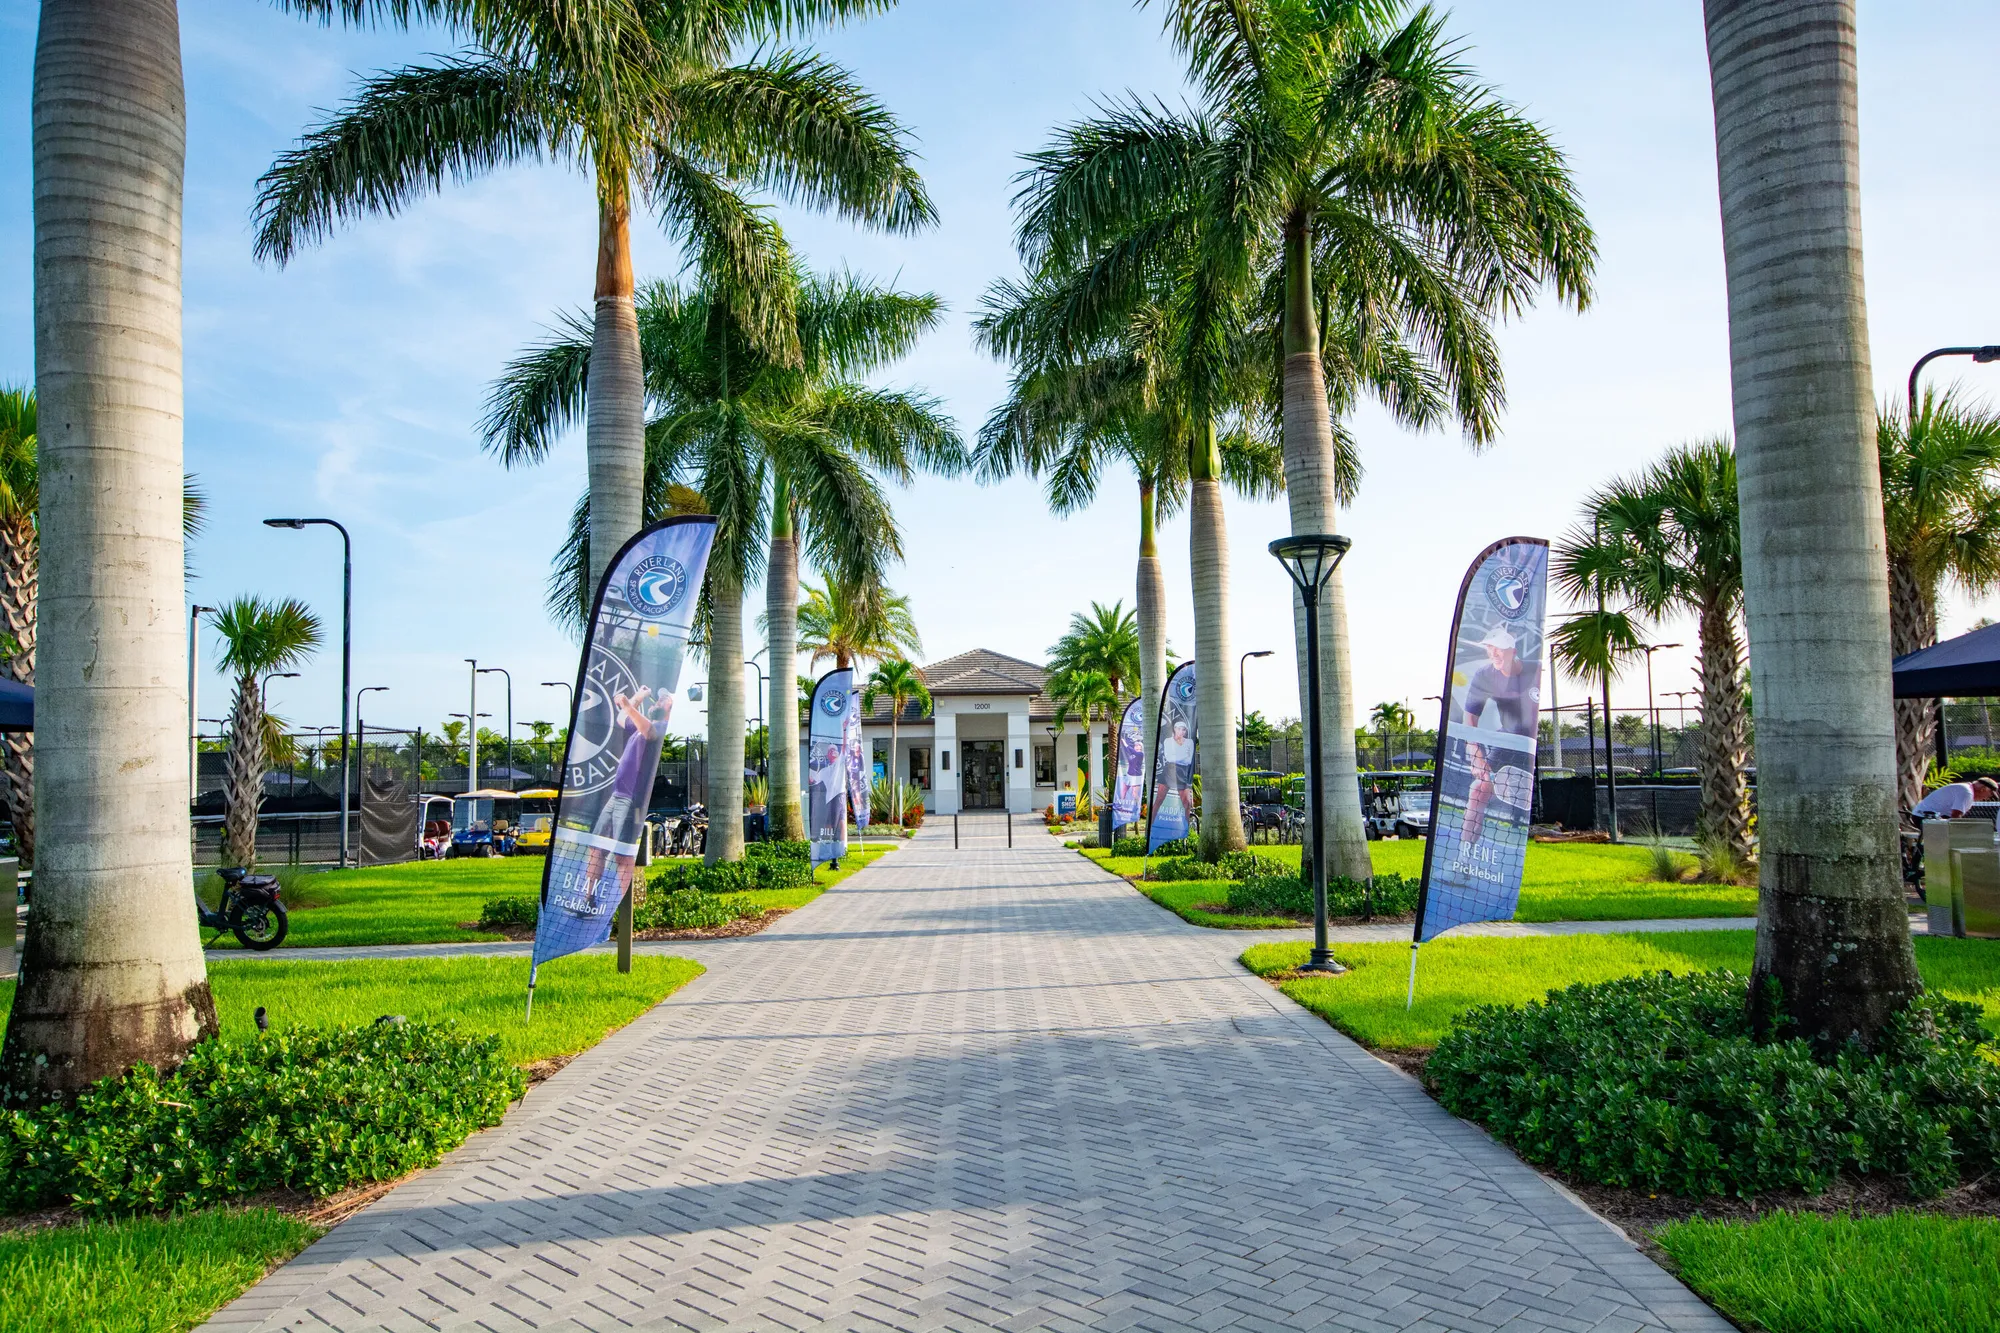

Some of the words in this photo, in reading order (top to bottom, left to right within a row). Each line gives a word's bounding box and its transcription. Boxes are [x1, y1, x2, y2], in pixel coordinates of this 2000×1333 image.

[634, 557, 685, 583] RIVERLAND
[629, 580, 640, 603] SPORTS
[641, 602, 673, 614] RACQUET
[672, 587, 684, 603] CLUB
[820, 827, 835, 836] BILL
[1463, 841, 1499, 866] RENE
[1452, 861, 1504, 884] Pickleball
[562, 872, 610, 899] BLAKE
[553, 895, 607, 915] Pickleball
